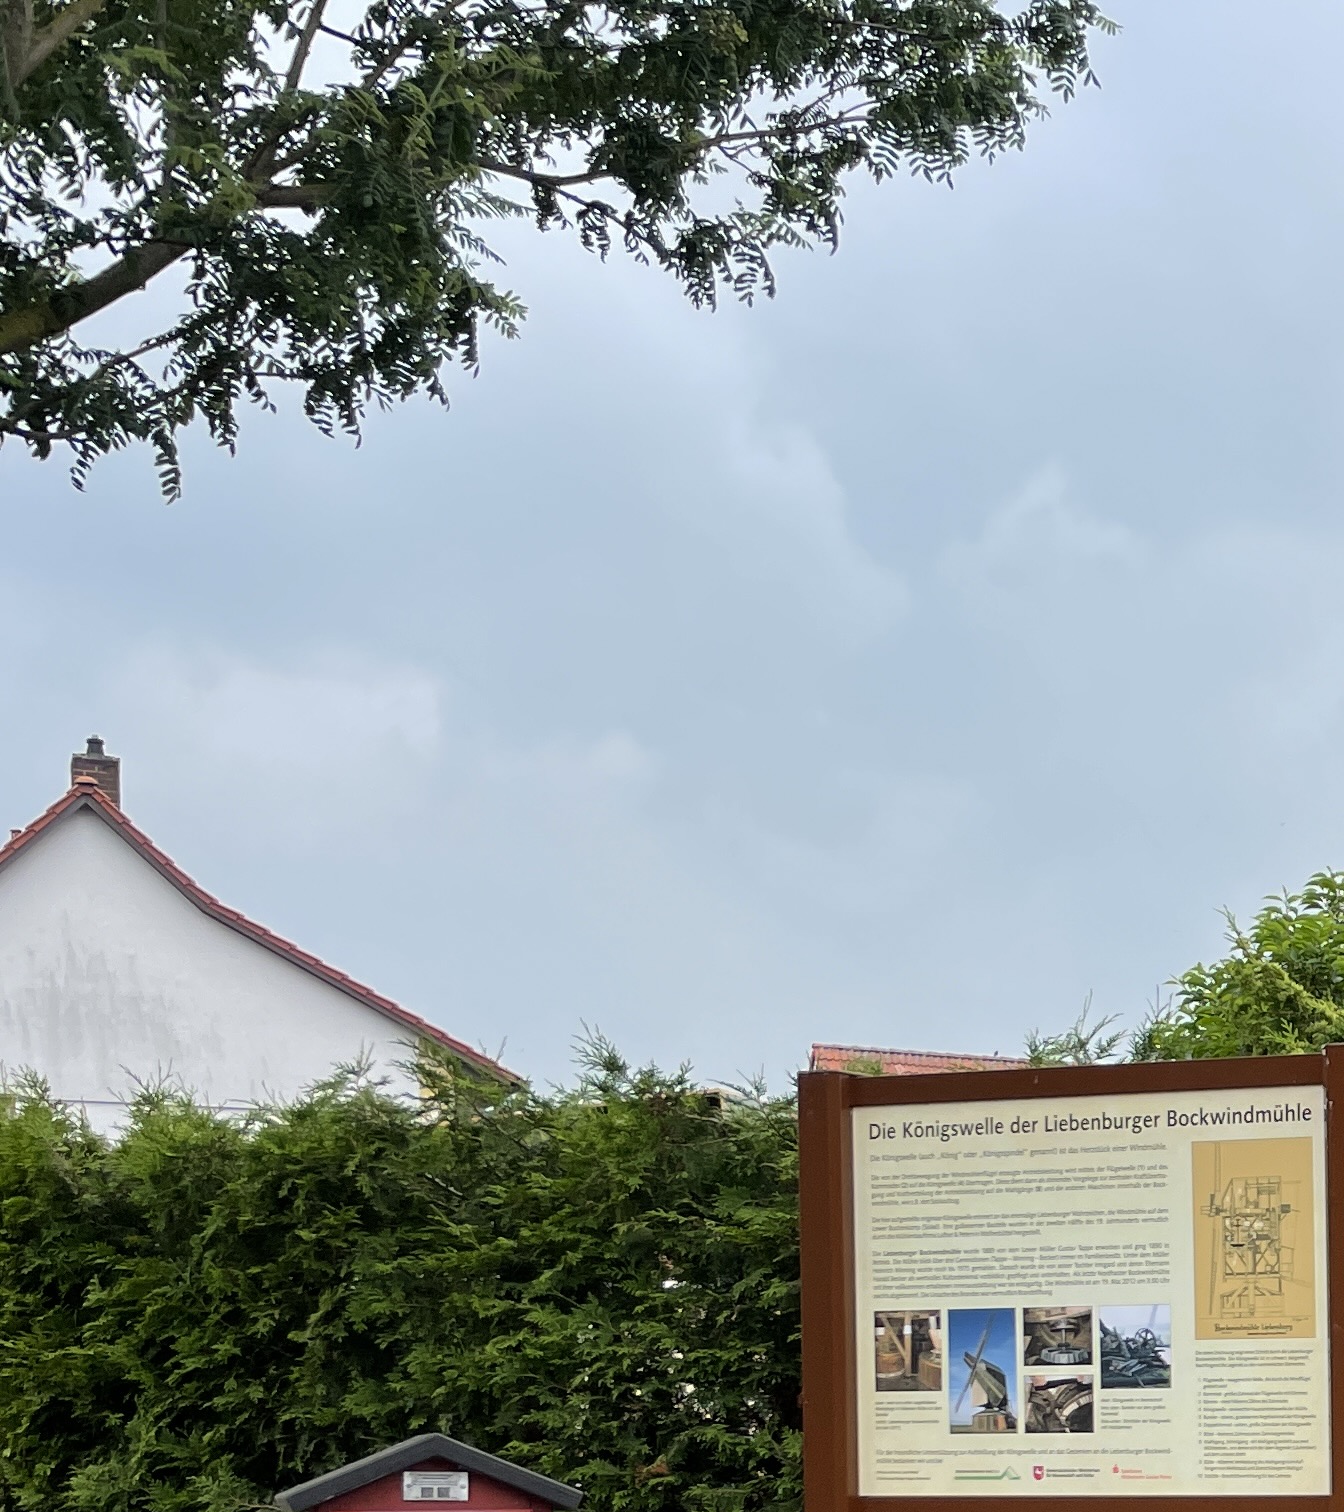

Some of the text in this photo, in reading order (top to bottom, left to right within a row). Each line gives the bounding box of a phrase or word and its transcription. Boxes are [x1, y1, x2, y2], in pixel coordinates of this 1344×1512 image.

[868, 1102, 1313, 1143] Die Königswelle der Liebenburger Bockwindmühle
